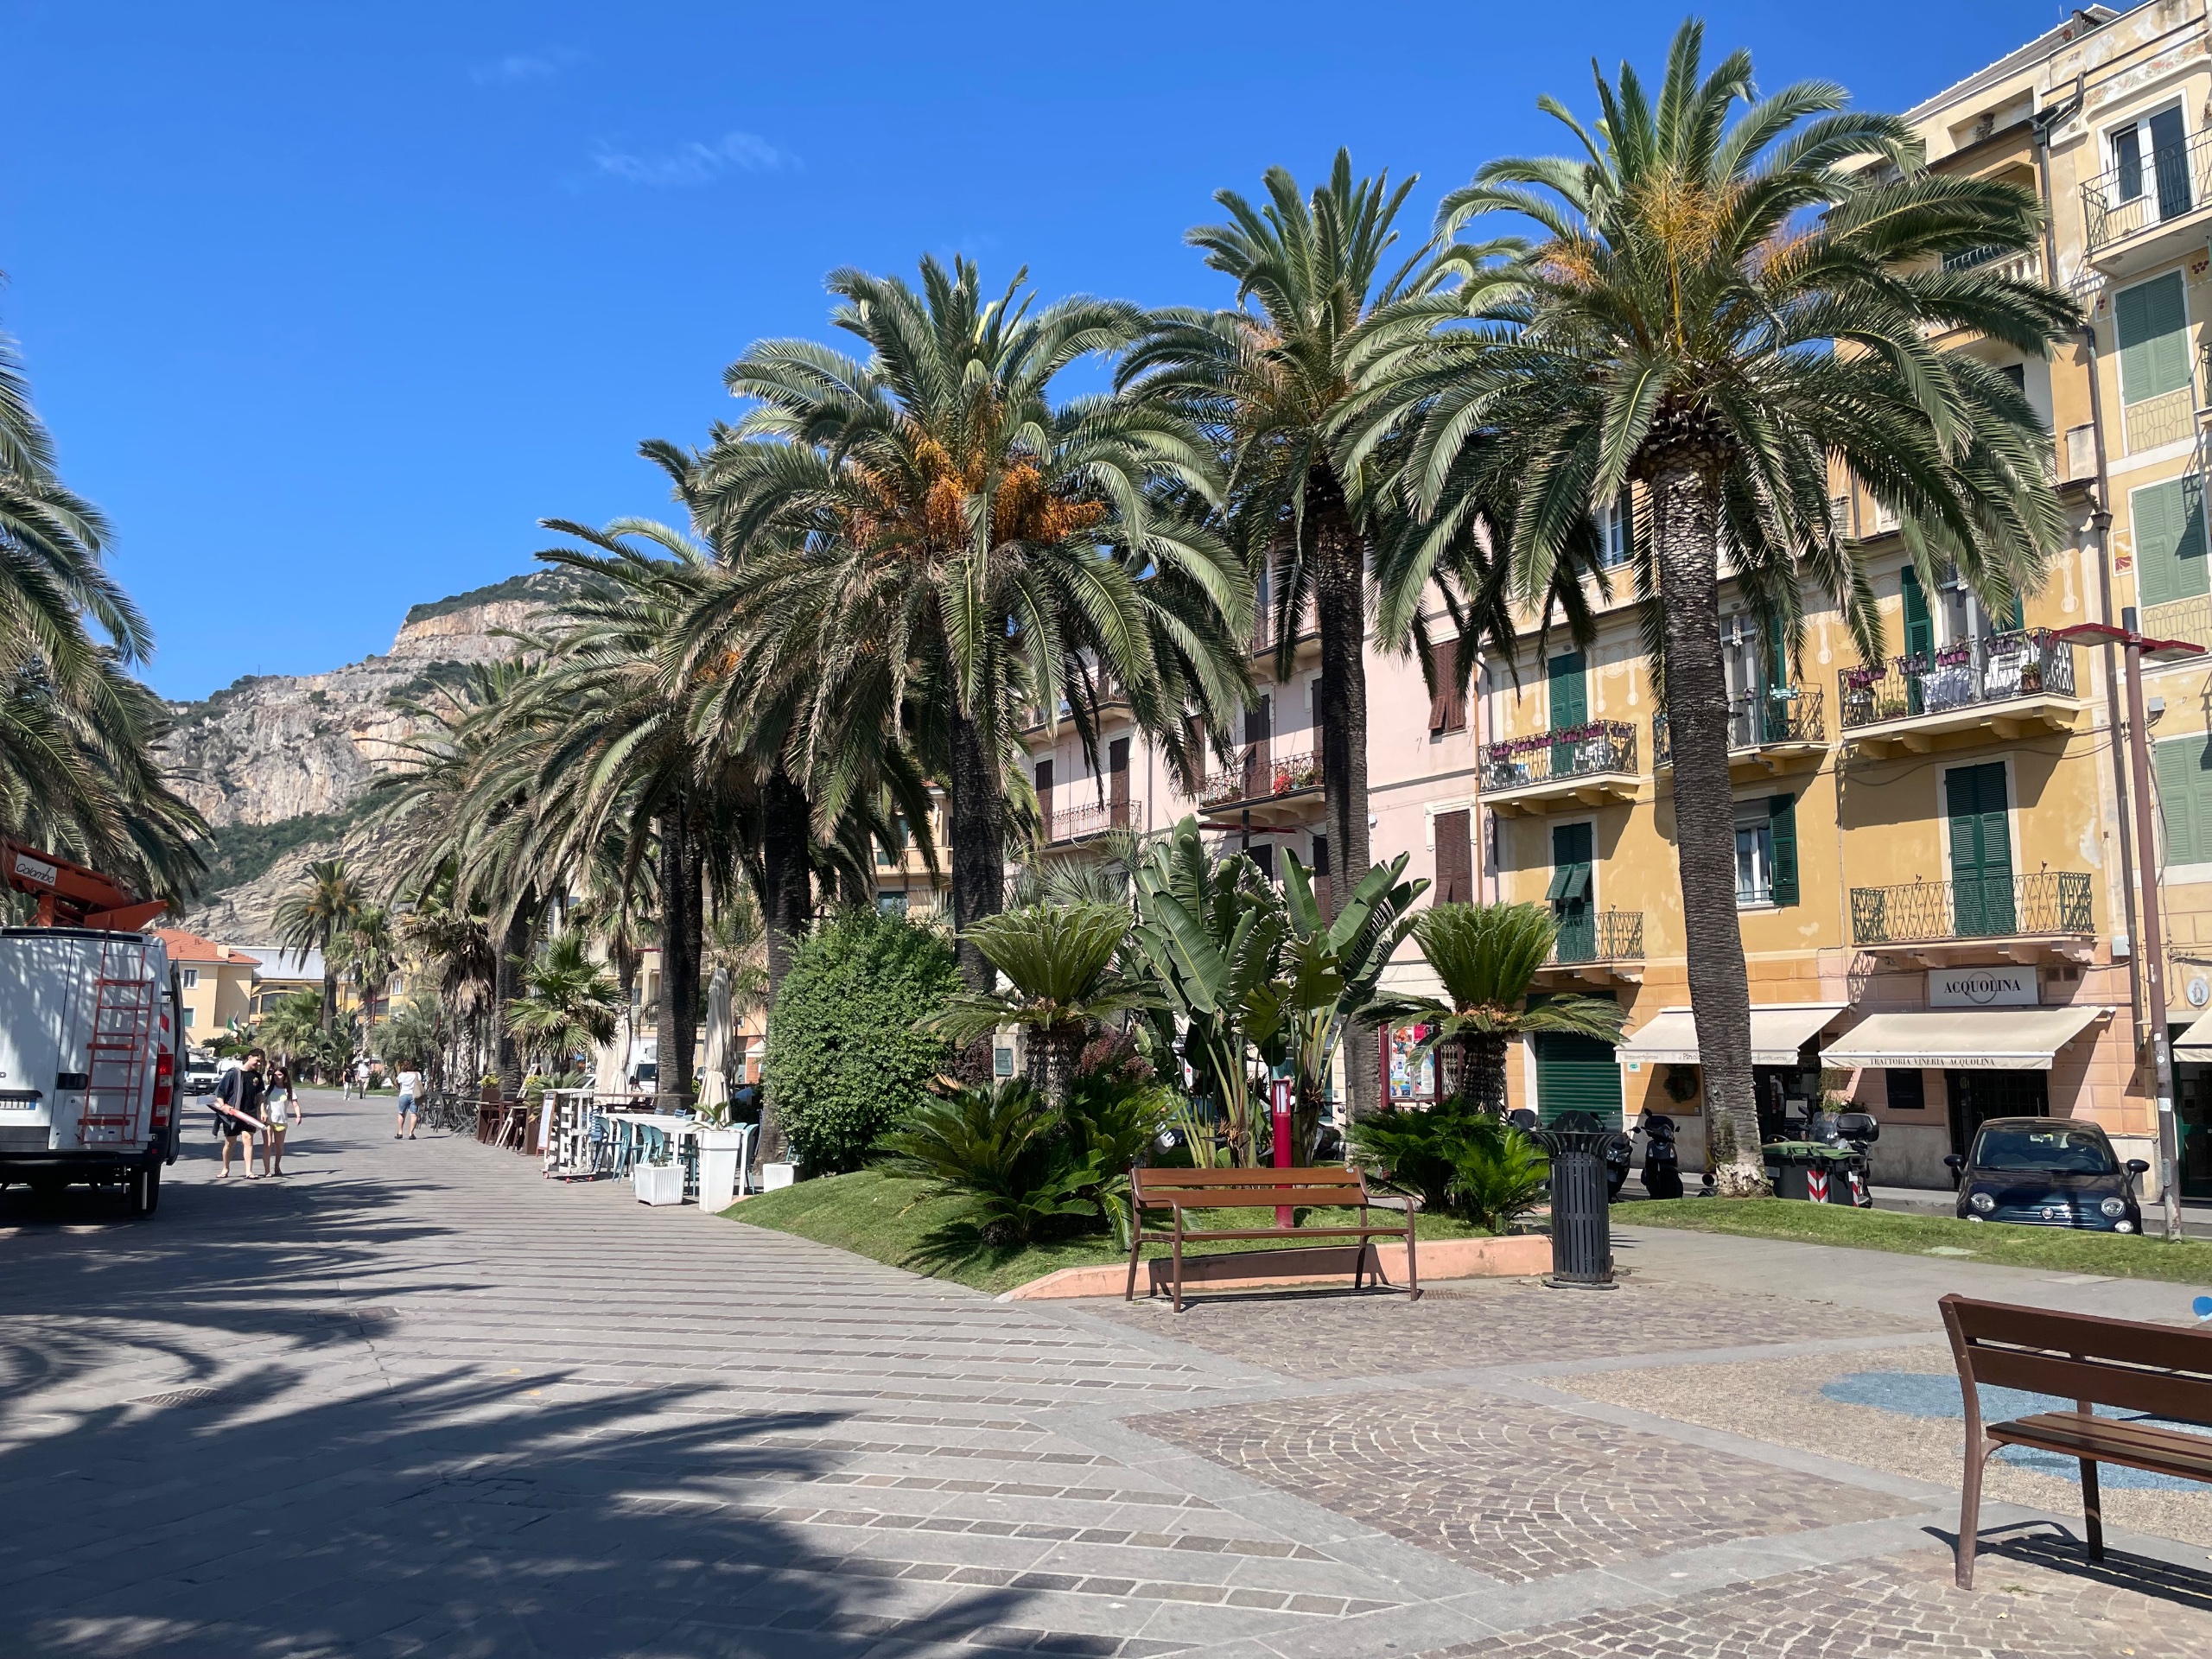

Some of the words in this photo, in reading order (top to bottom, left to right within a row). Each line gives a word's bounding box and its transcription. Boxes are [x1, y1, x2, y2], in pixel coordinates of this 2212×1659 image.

[16, 863, 54, 883] Colombo
[1944, 979, 2022, 996] ACQUOLINA
[1949, 1058, 1995, 1067] ACQUOLINA
